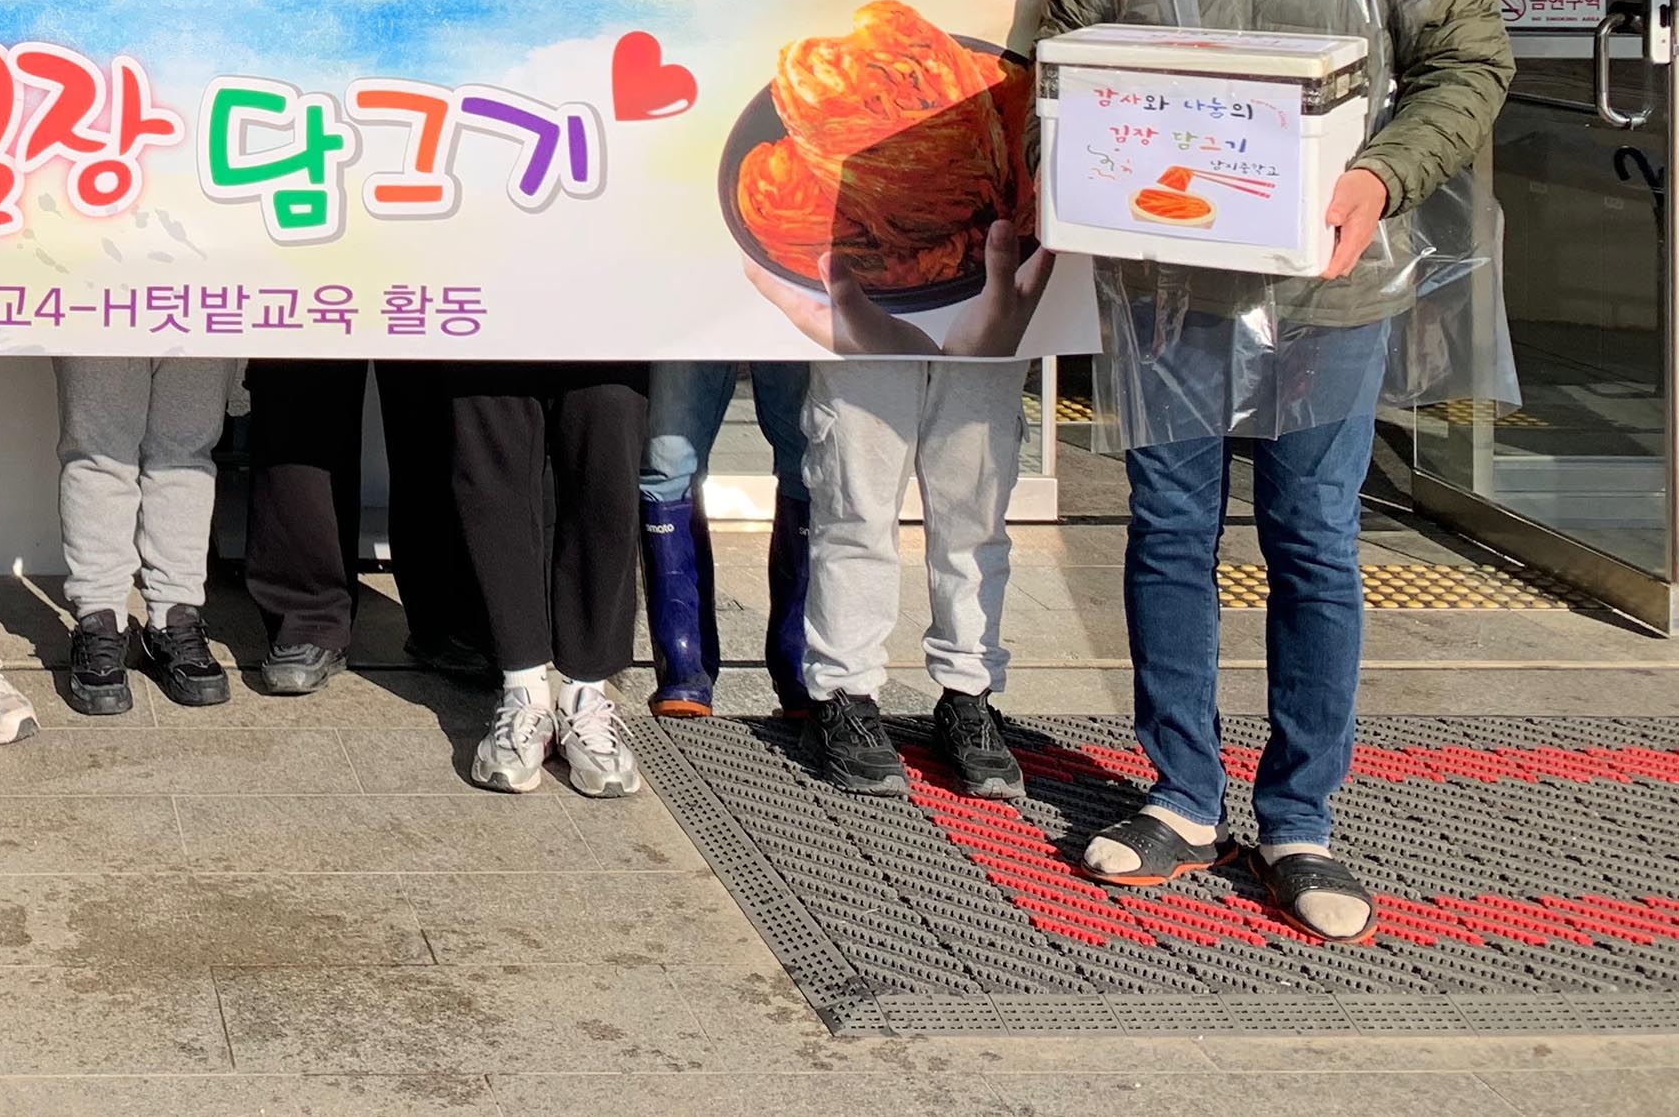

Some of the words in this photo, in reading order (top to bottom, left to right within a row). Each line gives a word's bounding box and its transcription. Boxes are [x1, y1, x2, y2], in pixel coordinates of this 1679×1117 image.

[1094, 87, 1170, 111] 감사와
[1183, 96, 1254, 120] 나눔의
[209, 86, 589, 230] 담그기
[1109, 125, 1159, 145] 김장
[1172, 130, 1247, 153] 담그기
[380, 283, 488, 337] 활동
